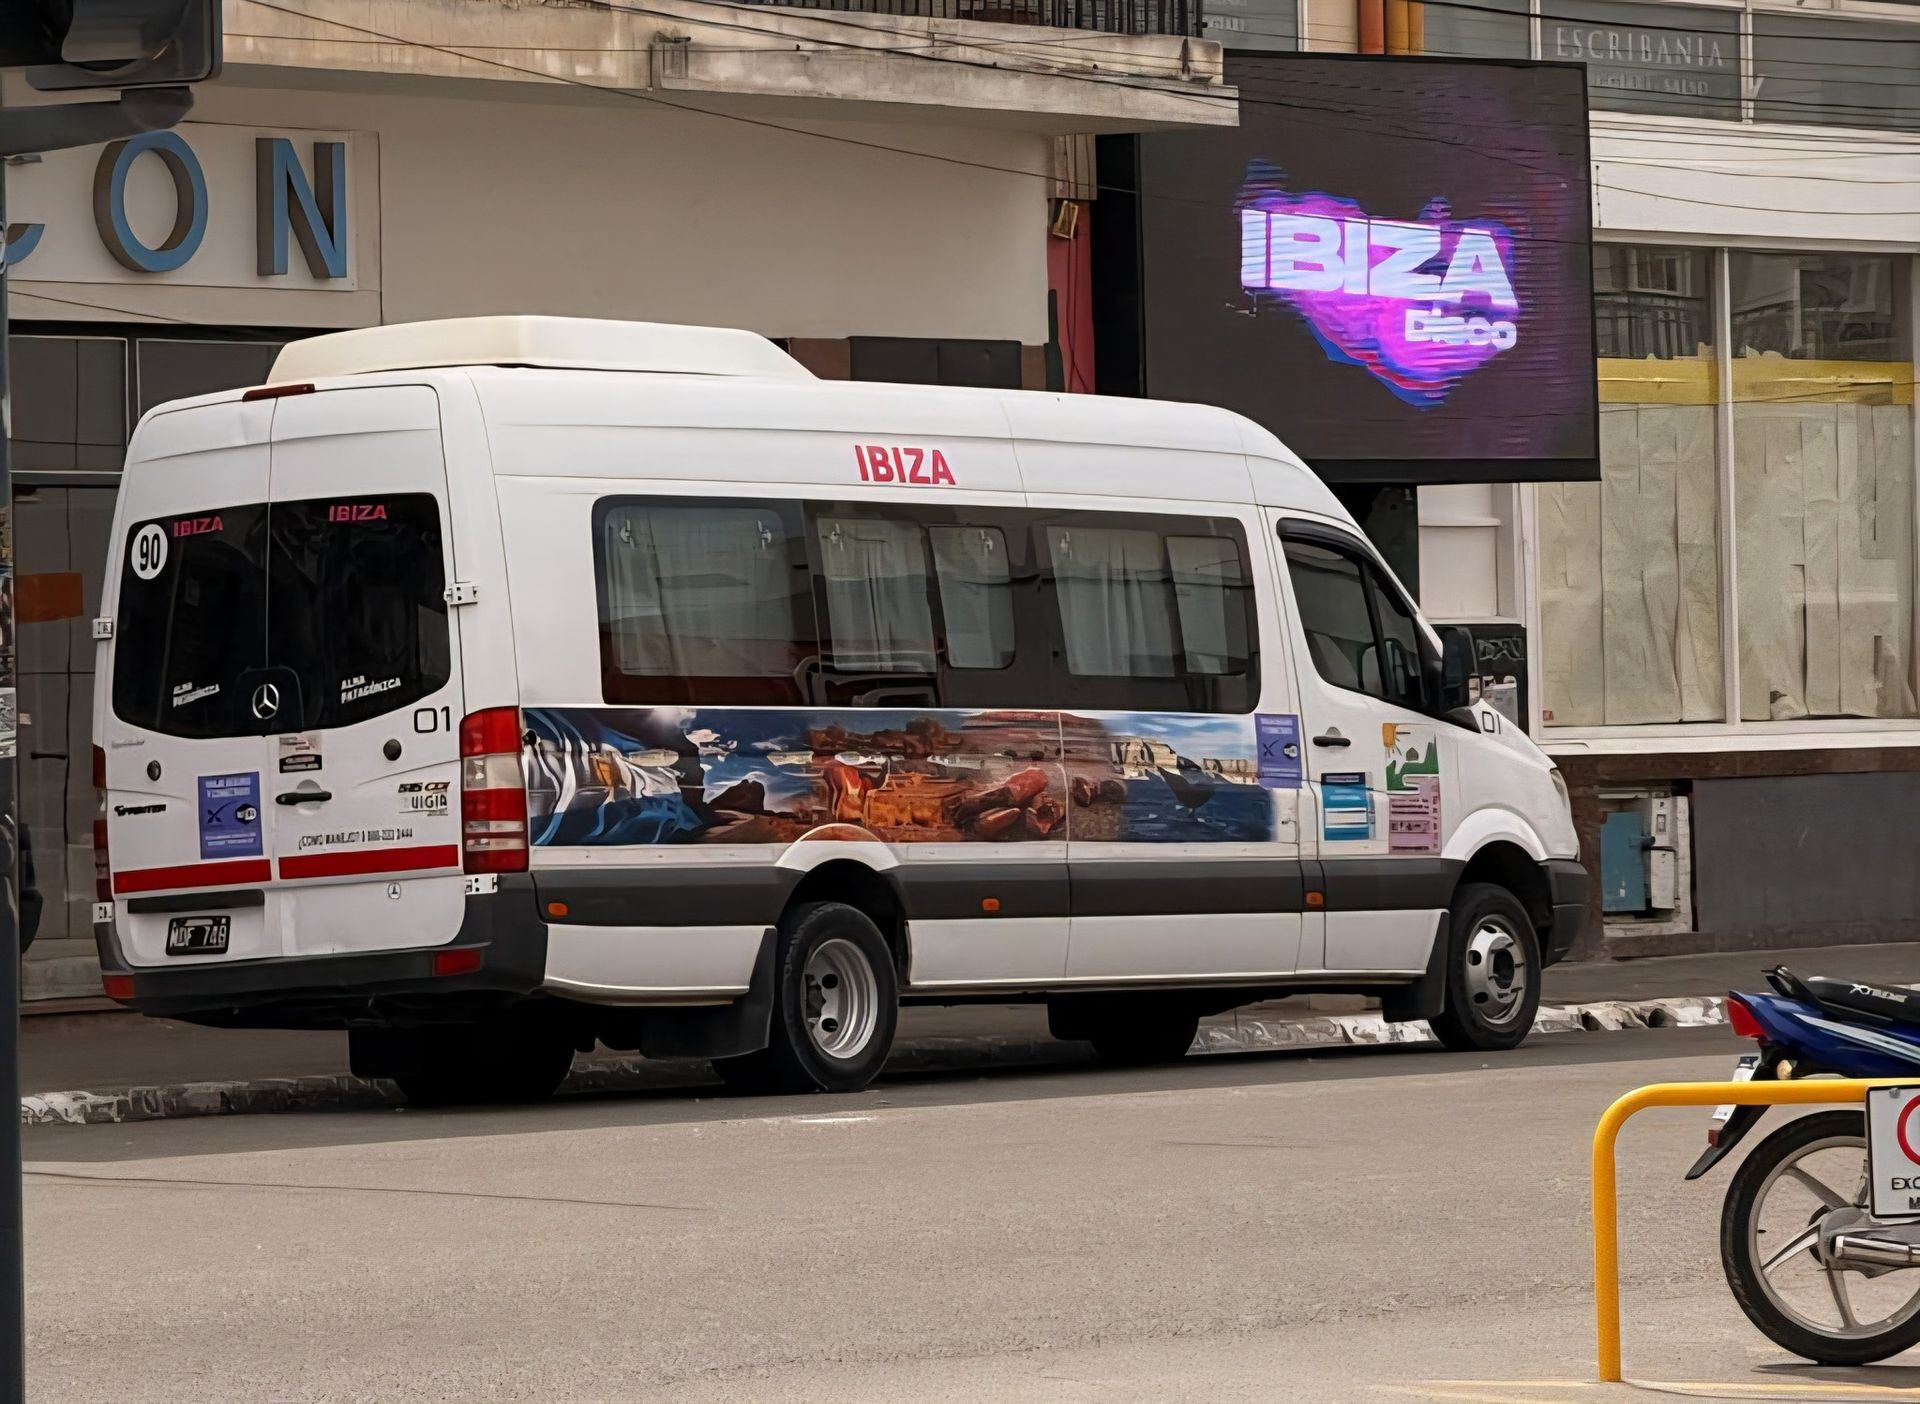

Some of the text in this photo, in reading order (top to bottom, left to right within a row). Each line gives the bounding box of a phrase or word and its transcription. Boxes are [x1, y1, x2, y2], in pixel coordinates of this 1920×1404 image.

[5, 131, 347, 279] ON
[1241, 209, 1519, 310] IBIZA
[855, 445, 956, 485] IBIZA
[173, 516, 224, 538] IBIZA
[329, 505, 388, 522] IBIZA
[139, 533, 161, 571] 90
[414, 706, 451, 733] 01
